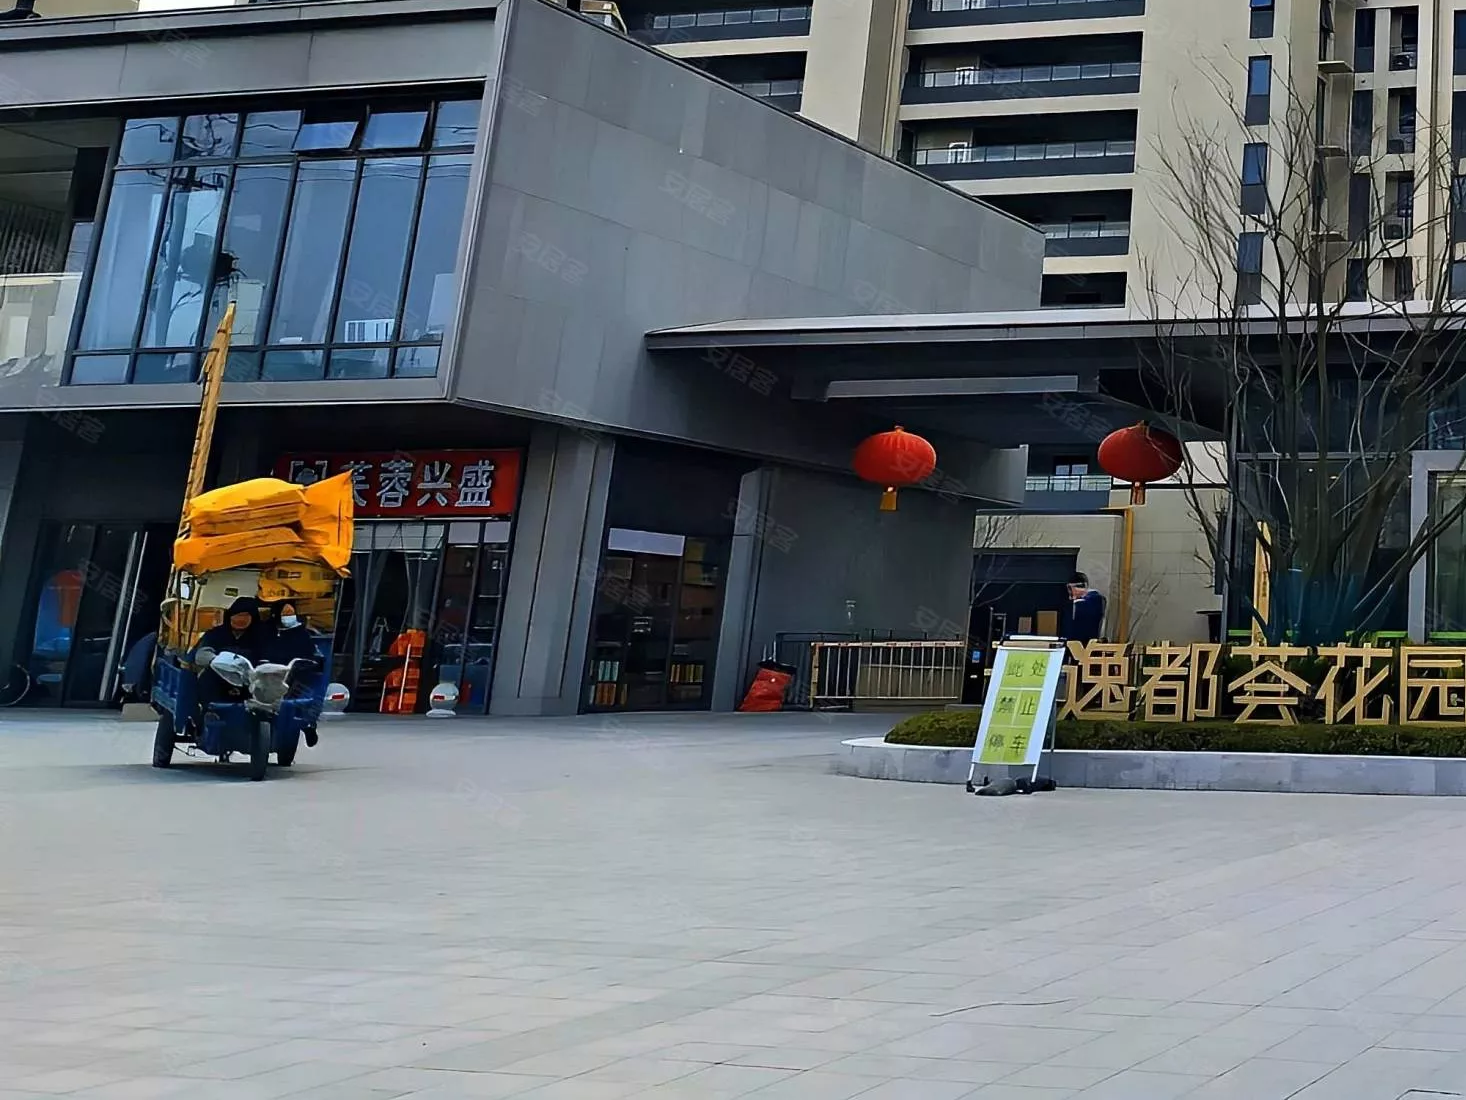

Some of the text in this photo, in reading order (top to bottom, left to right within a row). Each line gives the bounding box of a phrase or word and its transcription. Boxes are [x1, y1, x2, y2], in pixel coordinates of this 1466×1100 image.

[340, 459, 495, 507] 芙蓉兴盛
[1006, 659, 1046, 678] 此处
[996, 695, 1037, 716] 禁止
